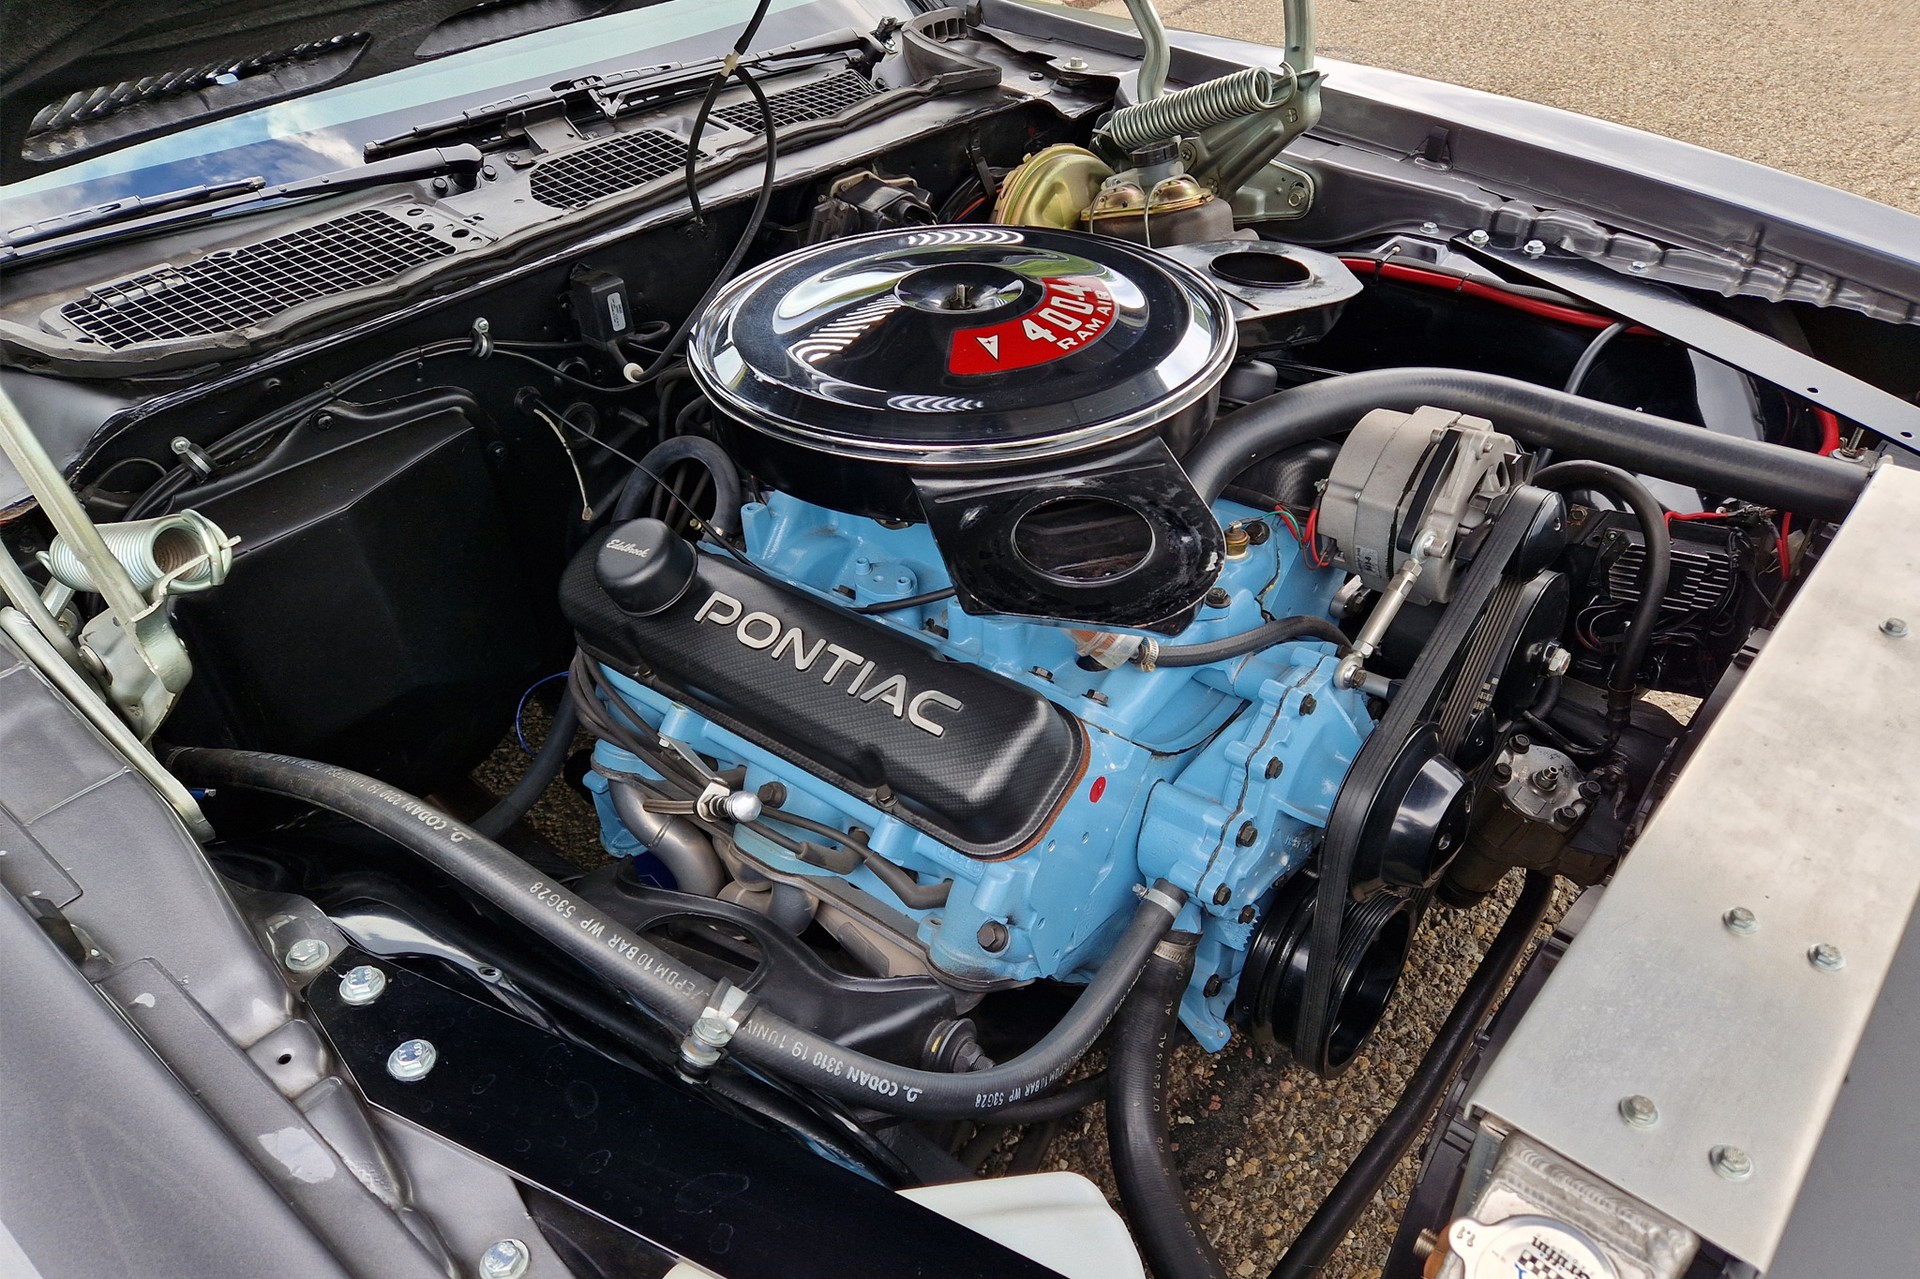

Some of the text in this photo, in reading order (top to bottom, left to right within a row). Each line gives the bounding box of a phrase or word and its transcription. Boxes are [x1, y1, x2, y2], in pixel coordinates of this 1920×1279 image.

[1056, 290, 1112, 350] RAM AIR
[605, 538, 651, 558] Edelbrock
[694, 590, 963, 737] PONTIAC
[403, 801, 447, 830] CODAN
[528, 881, 577, 919] 53G28
[579, 917, 606, 938] WP
[1158, 1032, 1168, 1048] AL
[812, 1051, 844, 1076] 3310
[846, 1066, 899, 1097] CODAN
[974, 1091, 1005, 1108] 53G28
[1008, 1086, 1022, 1103] WP
